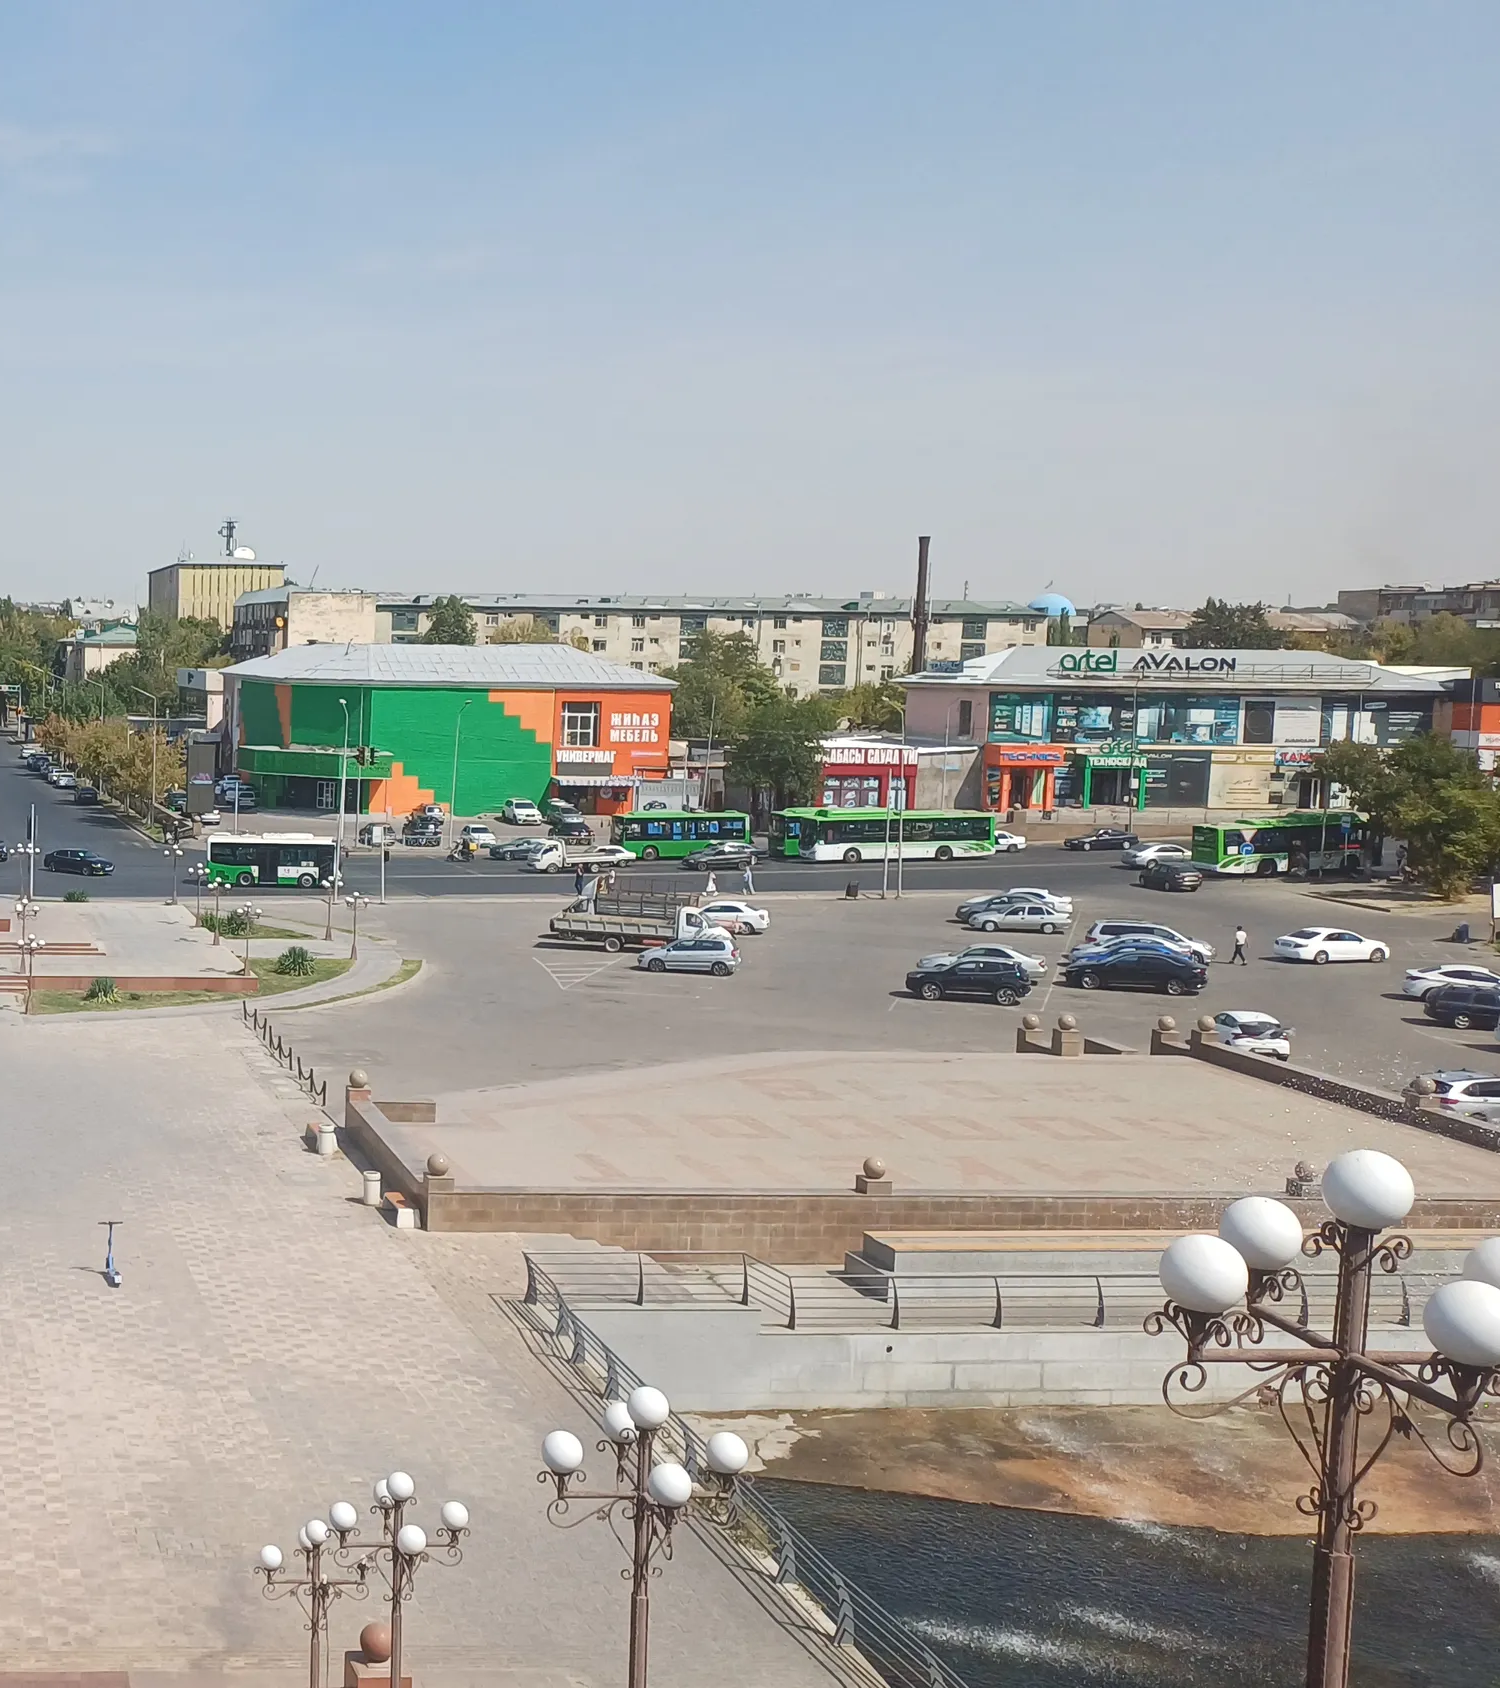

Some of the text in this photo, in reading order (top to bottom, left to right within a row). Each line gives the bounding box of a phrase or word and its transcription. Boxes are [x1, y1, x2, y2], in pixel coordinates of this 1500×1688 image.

[1060, 650, 1236, 672] artel AVALON
[610, 729, 659, 742] МЕБЕЛЬ
[556, 750, 616, 763] УНИВЕРМАГ
